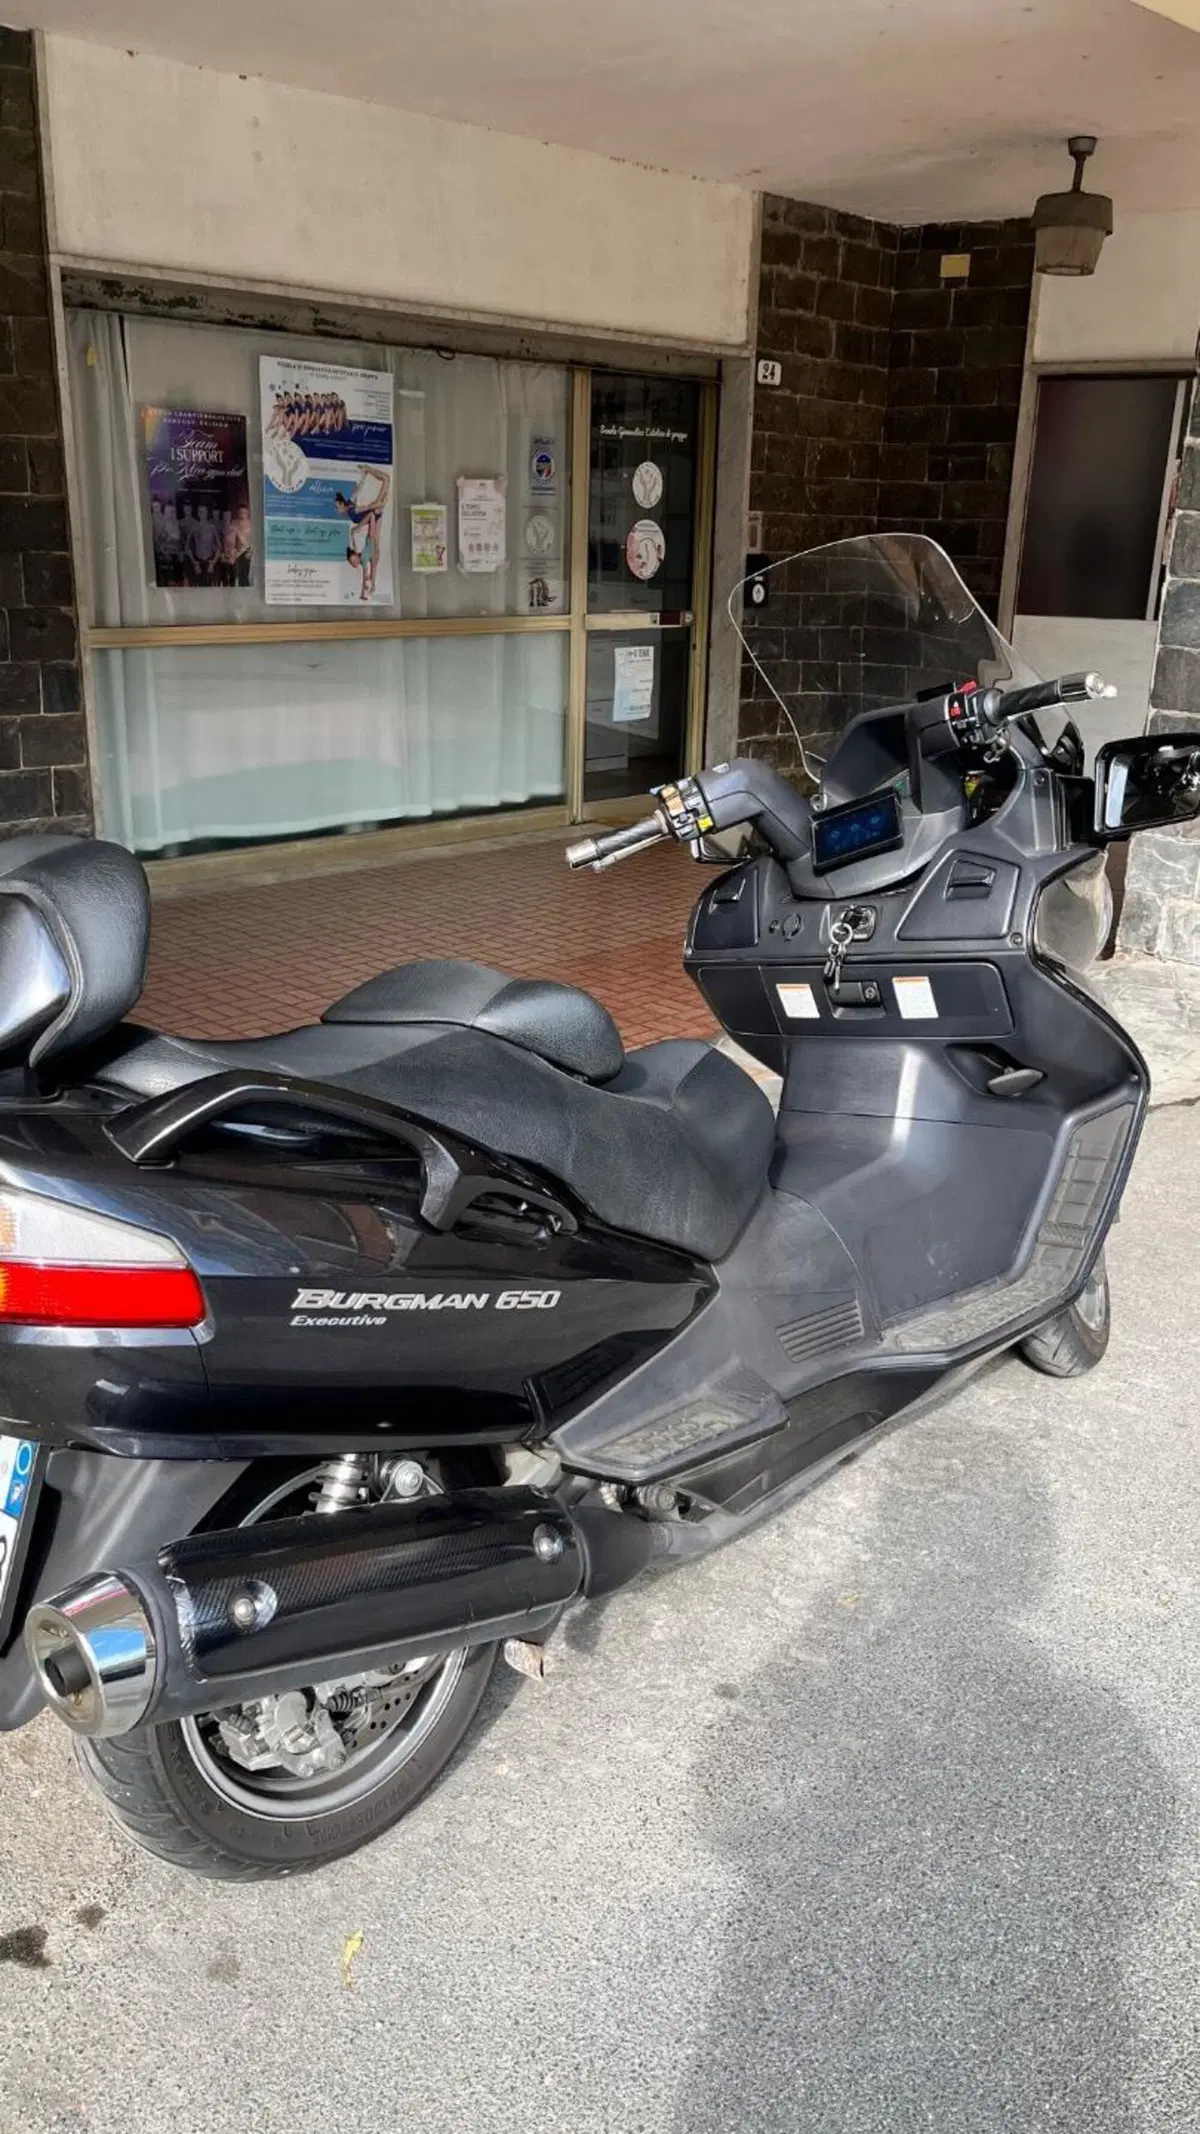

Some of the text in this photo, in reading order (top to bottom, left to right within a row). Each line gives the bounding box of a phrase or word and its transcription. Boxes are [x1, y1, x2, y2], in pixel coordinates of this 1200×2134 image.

[176, 448, 225, 463] SUPPORT
[495, 1290, 561, 1310] 650
[291, 1314, 388, 1327] Executive
